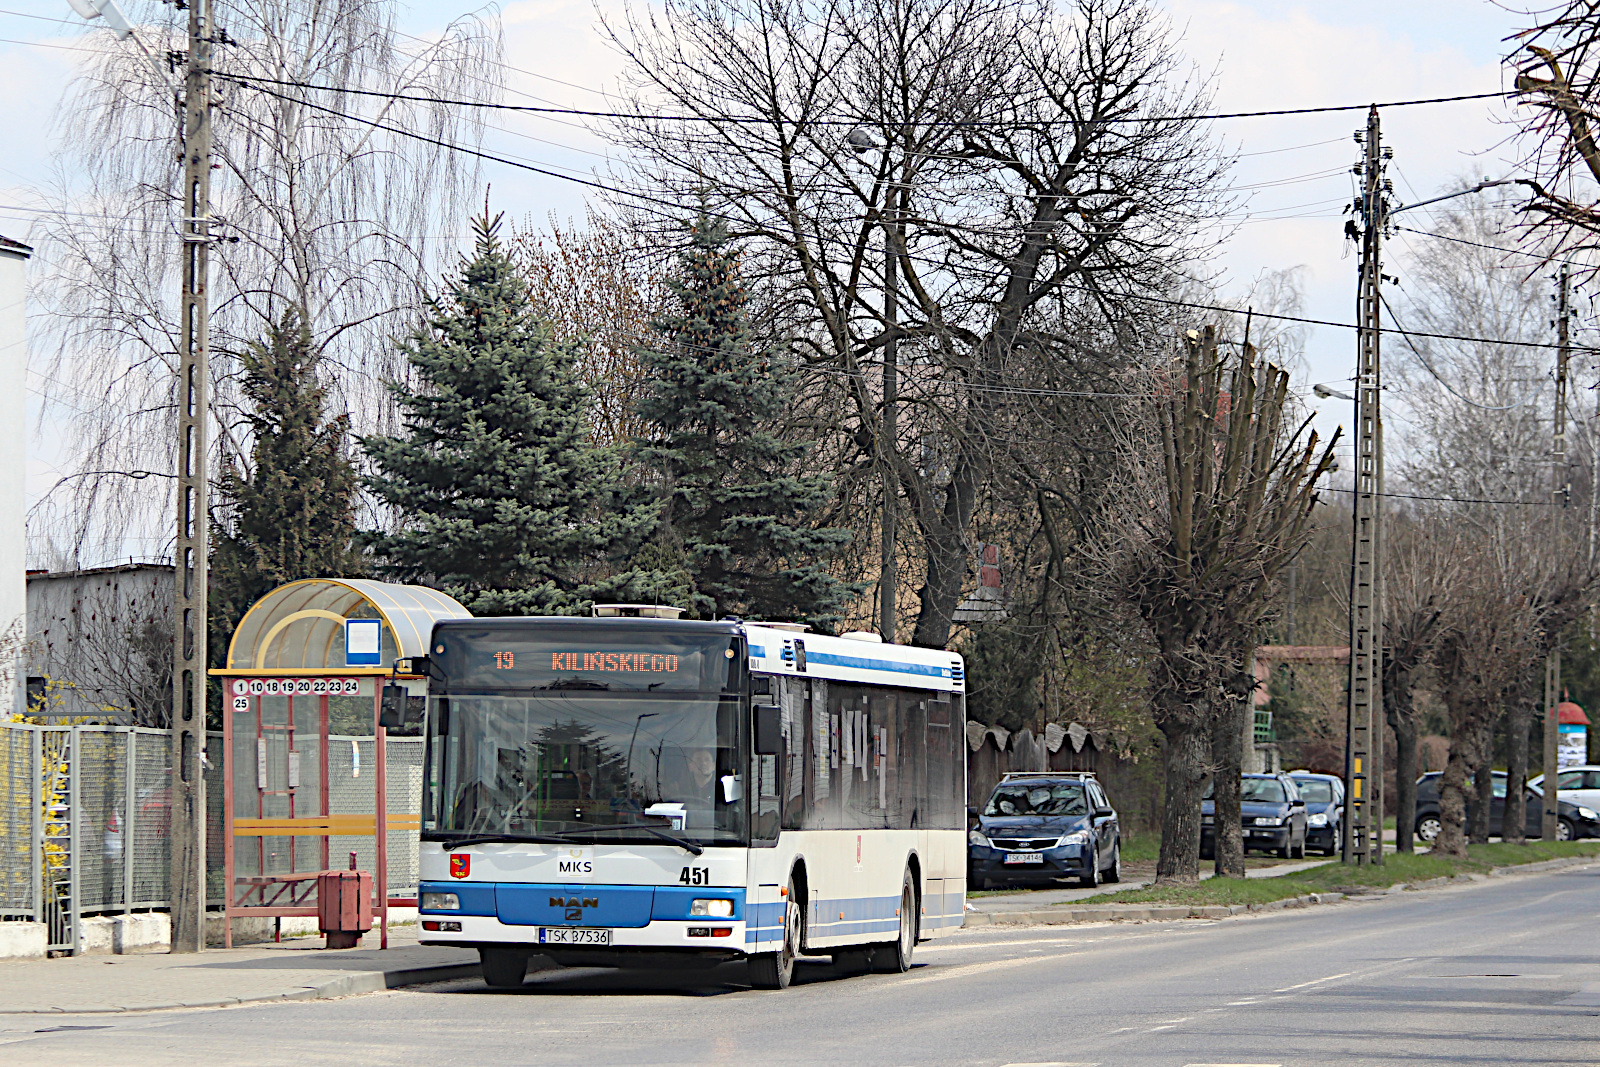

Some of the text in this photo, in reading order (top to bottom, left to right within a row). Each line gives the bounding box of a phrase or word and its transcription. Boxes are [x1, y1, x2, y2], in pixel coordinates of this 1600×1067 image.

[493, 651, 679, 672] 19 KILIŃSKIEGO
[238, 682, 357, 692] 1 10 18 19 20 22 23 24
[235, 699, 247, 708] 25
[559, 861, 593, 873] MKS
[679, 866, 709, 885] 451
[549, 897, 599, 908] MAN
[546, 929, 607, 943] TSK 37536
